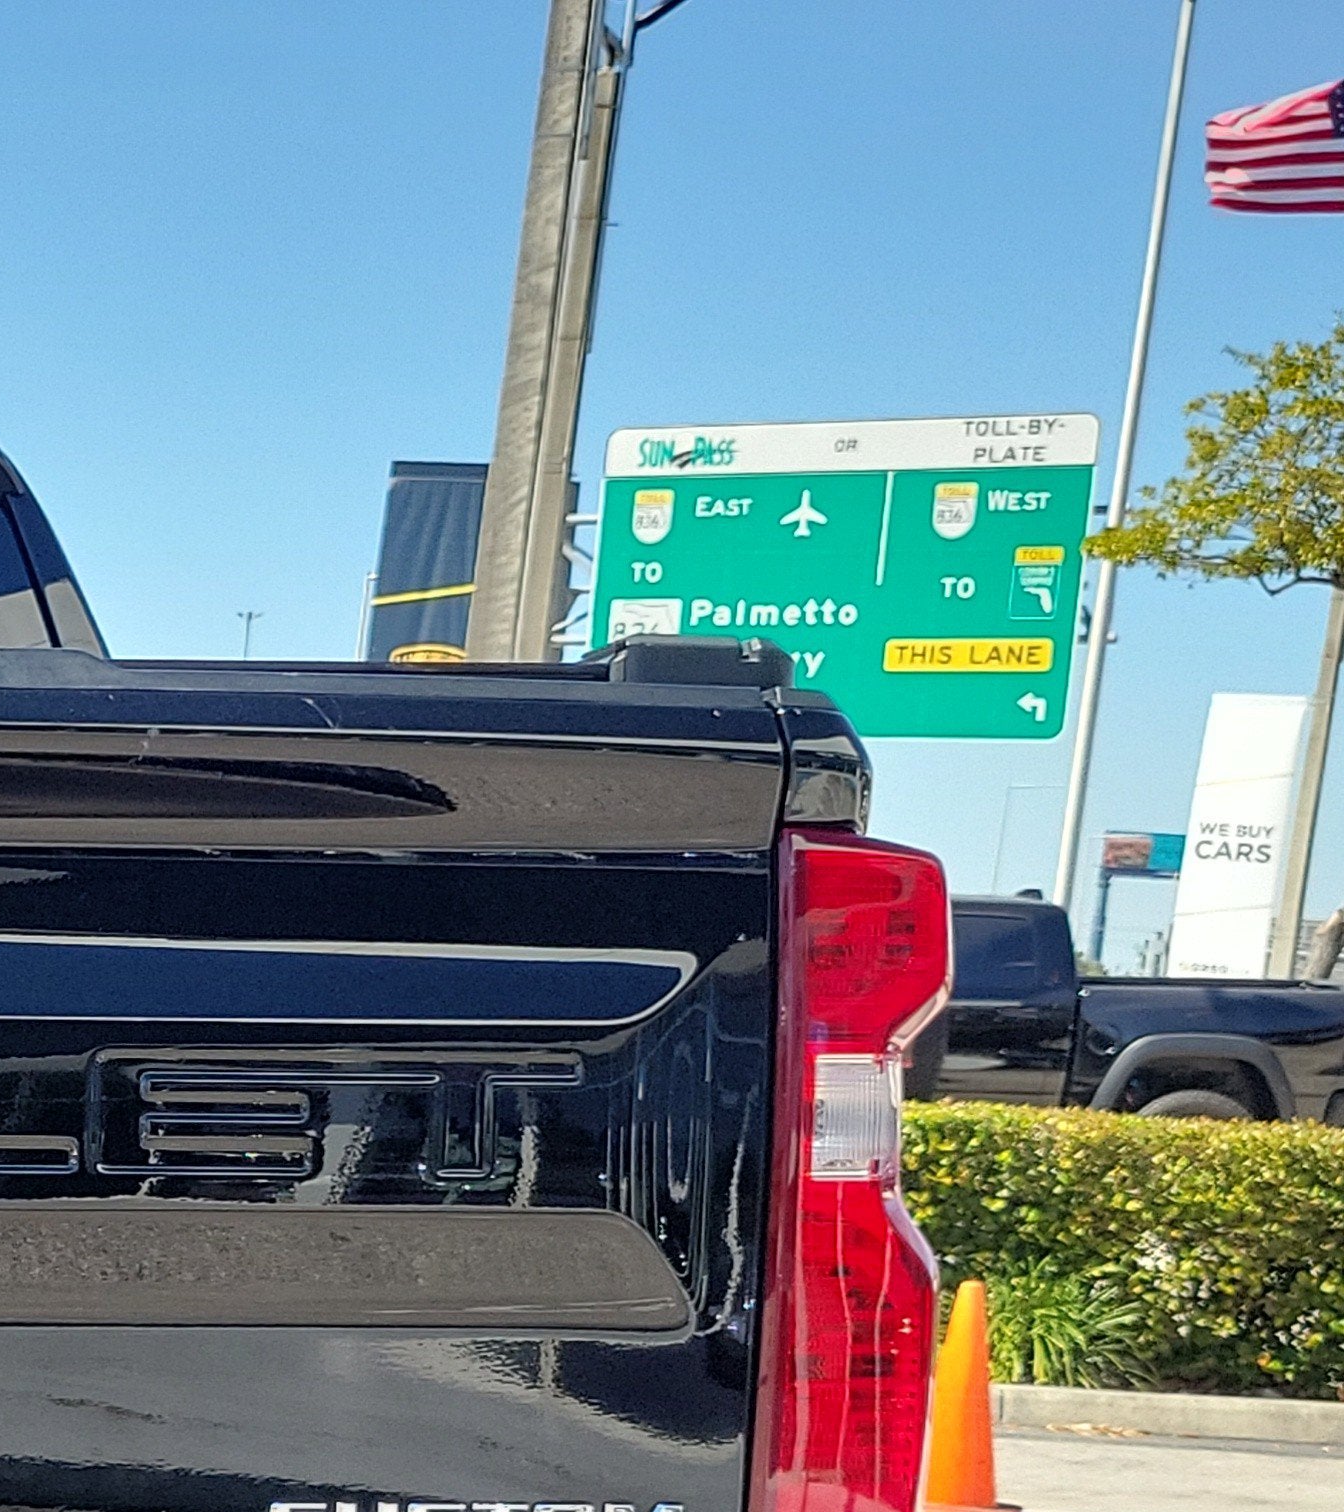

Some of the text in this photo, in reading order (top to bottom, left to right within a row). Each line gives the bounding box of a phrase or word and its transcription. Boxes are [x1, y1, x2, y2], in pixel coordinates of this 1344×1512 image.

[973, 446, 1048, 464] PLATE
[694, 496, 754, 518] EAST
[987, 490, 1052, 512] WEST
[631, 561, 663, 584] TO
[940, 576, 976, 599] TO
[689, 598, 859, 627] Palmetto
[895, 644, 1043, 665] THIS LANE
[1199, 822, 1275, 838] WE BUY
[1194, 840, 1271, 864] CARS
